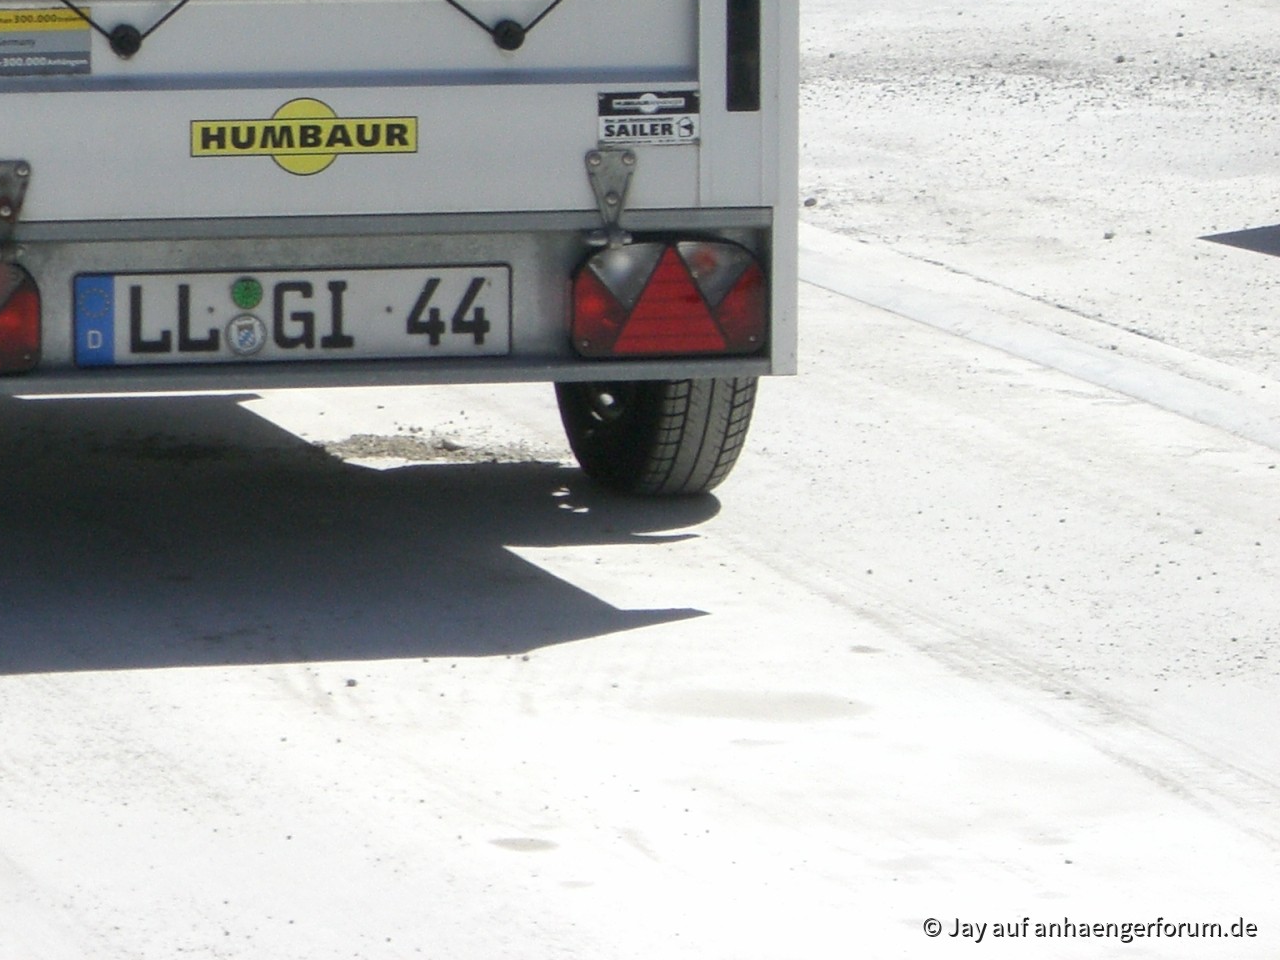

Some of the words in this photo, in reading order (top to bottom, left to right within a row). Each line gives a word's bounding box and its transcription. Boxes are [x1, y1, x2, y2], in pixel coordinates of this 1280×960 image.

[2, 56, 47, 68] 300.000
[200, 123, 409, 150] HUMBAUR
[604, 123, 674, 137] SAILER
[129, 283, 220, 354] LL
[272, 280, 355, 349] GI
[405, 277, 491, 346] 44
[87, 330, 102, 349] D
